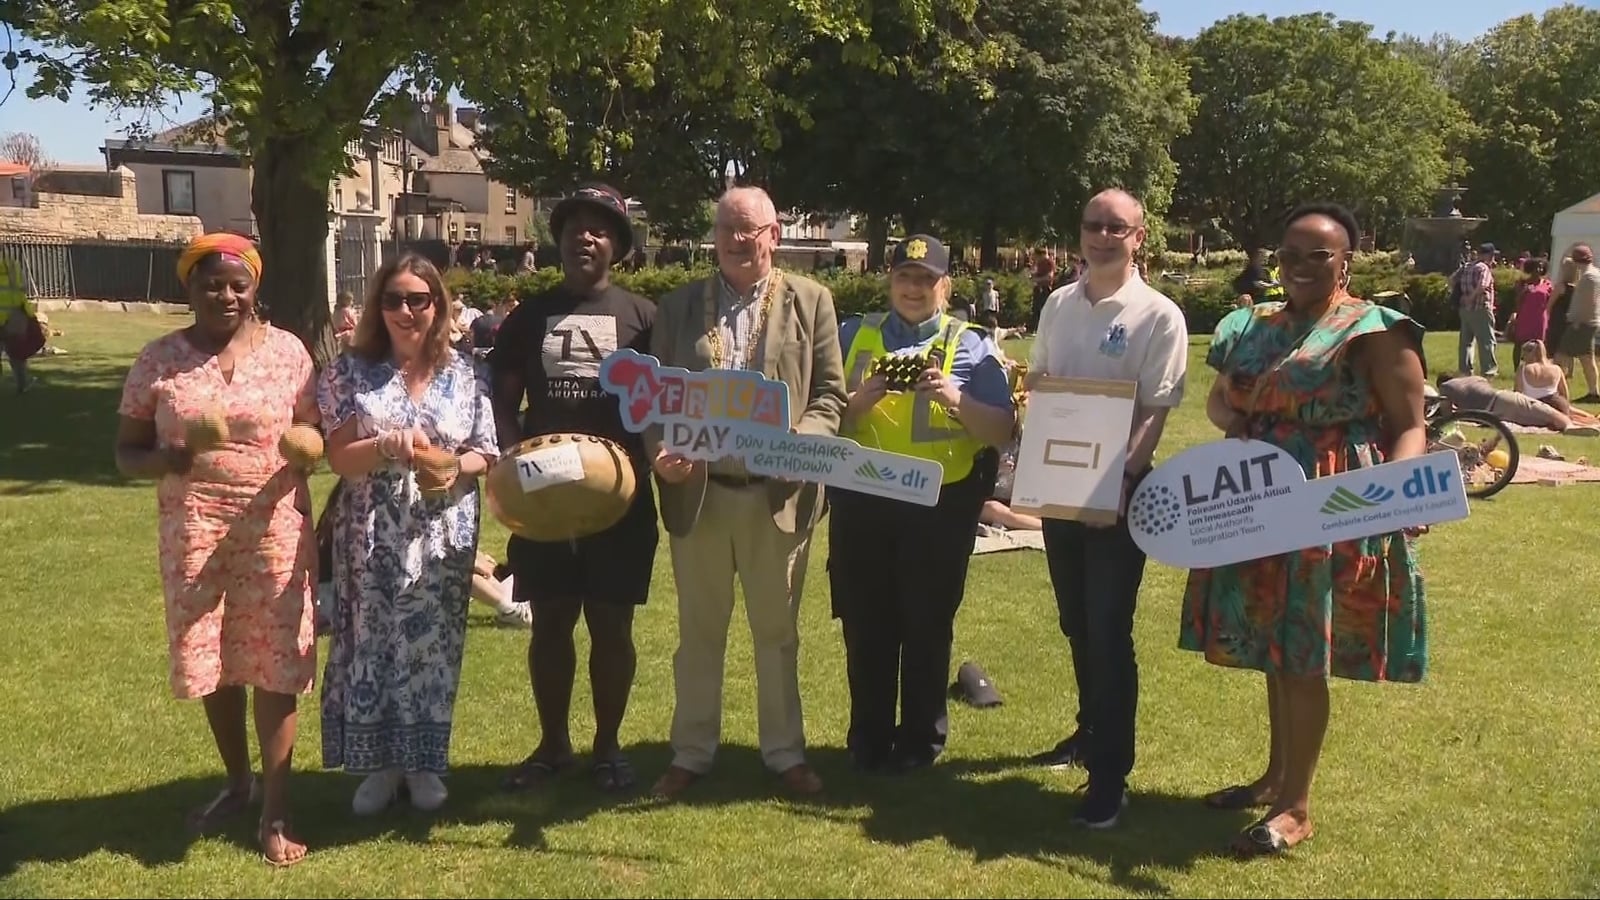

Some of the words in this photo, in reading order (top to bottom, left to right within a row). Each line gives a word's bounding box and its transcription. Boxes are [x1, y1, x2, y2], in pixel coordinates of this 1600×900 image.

[547, 390, 608, 399] ARUTURA
[548, 380, 580, 390] TURA
[626, 369, 782, 423] AFRICA
[672, 422, 731, 454] DAY
[753, 453, 833, 475] RATHDOWN
[901, 468, 929, 489] dlr
[1182, 452, 1280, 507] LAIT
[1402, 465, 1452, 499] dlr
[1188, 518, 1203, 527] um
[1189, 523, 1214, 536] Local
[1215, 516, 1255, 531] Authority
[1191, 530, 1239, 546] Integration
[1240, 524, 1265, 535] Team
